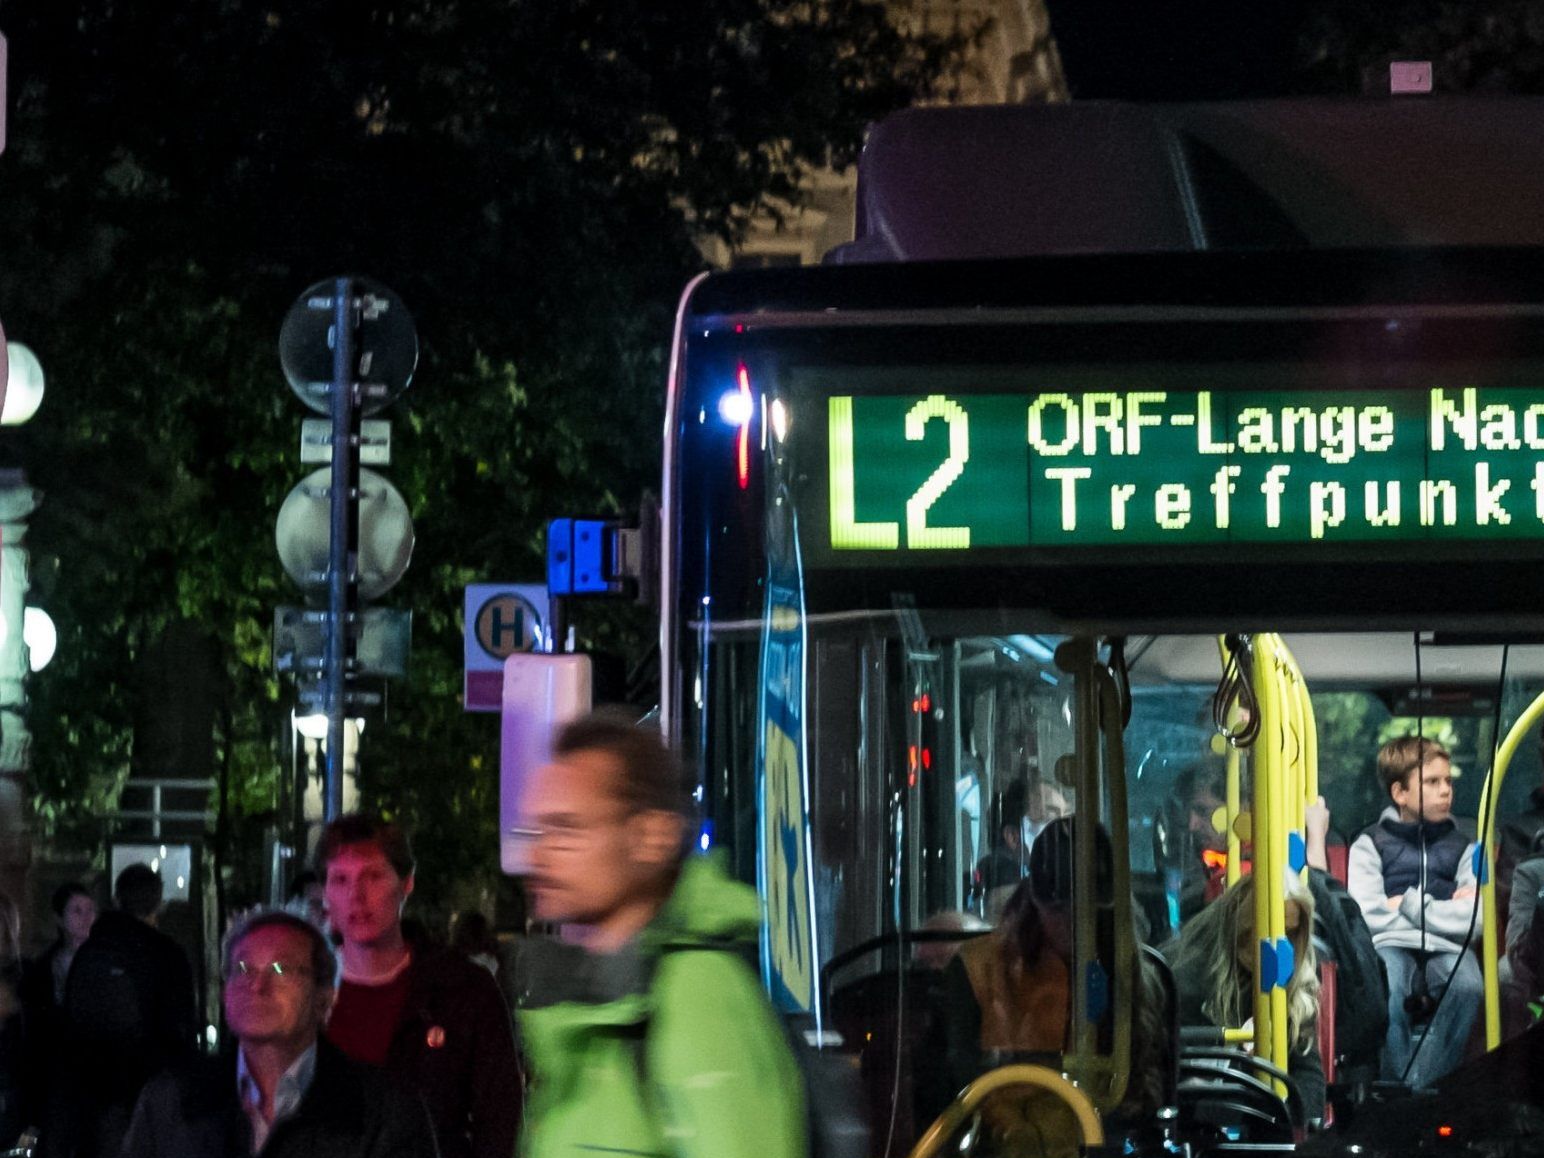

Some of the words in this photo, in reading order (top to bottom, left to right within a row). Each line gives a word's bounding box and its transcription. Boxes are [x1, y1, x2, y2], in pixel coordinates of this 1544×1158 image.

[1027, 390, 1394, 464] ORF-Lange
[829, 395, 970, 549] L2
[492, 606, 524, 648] H
